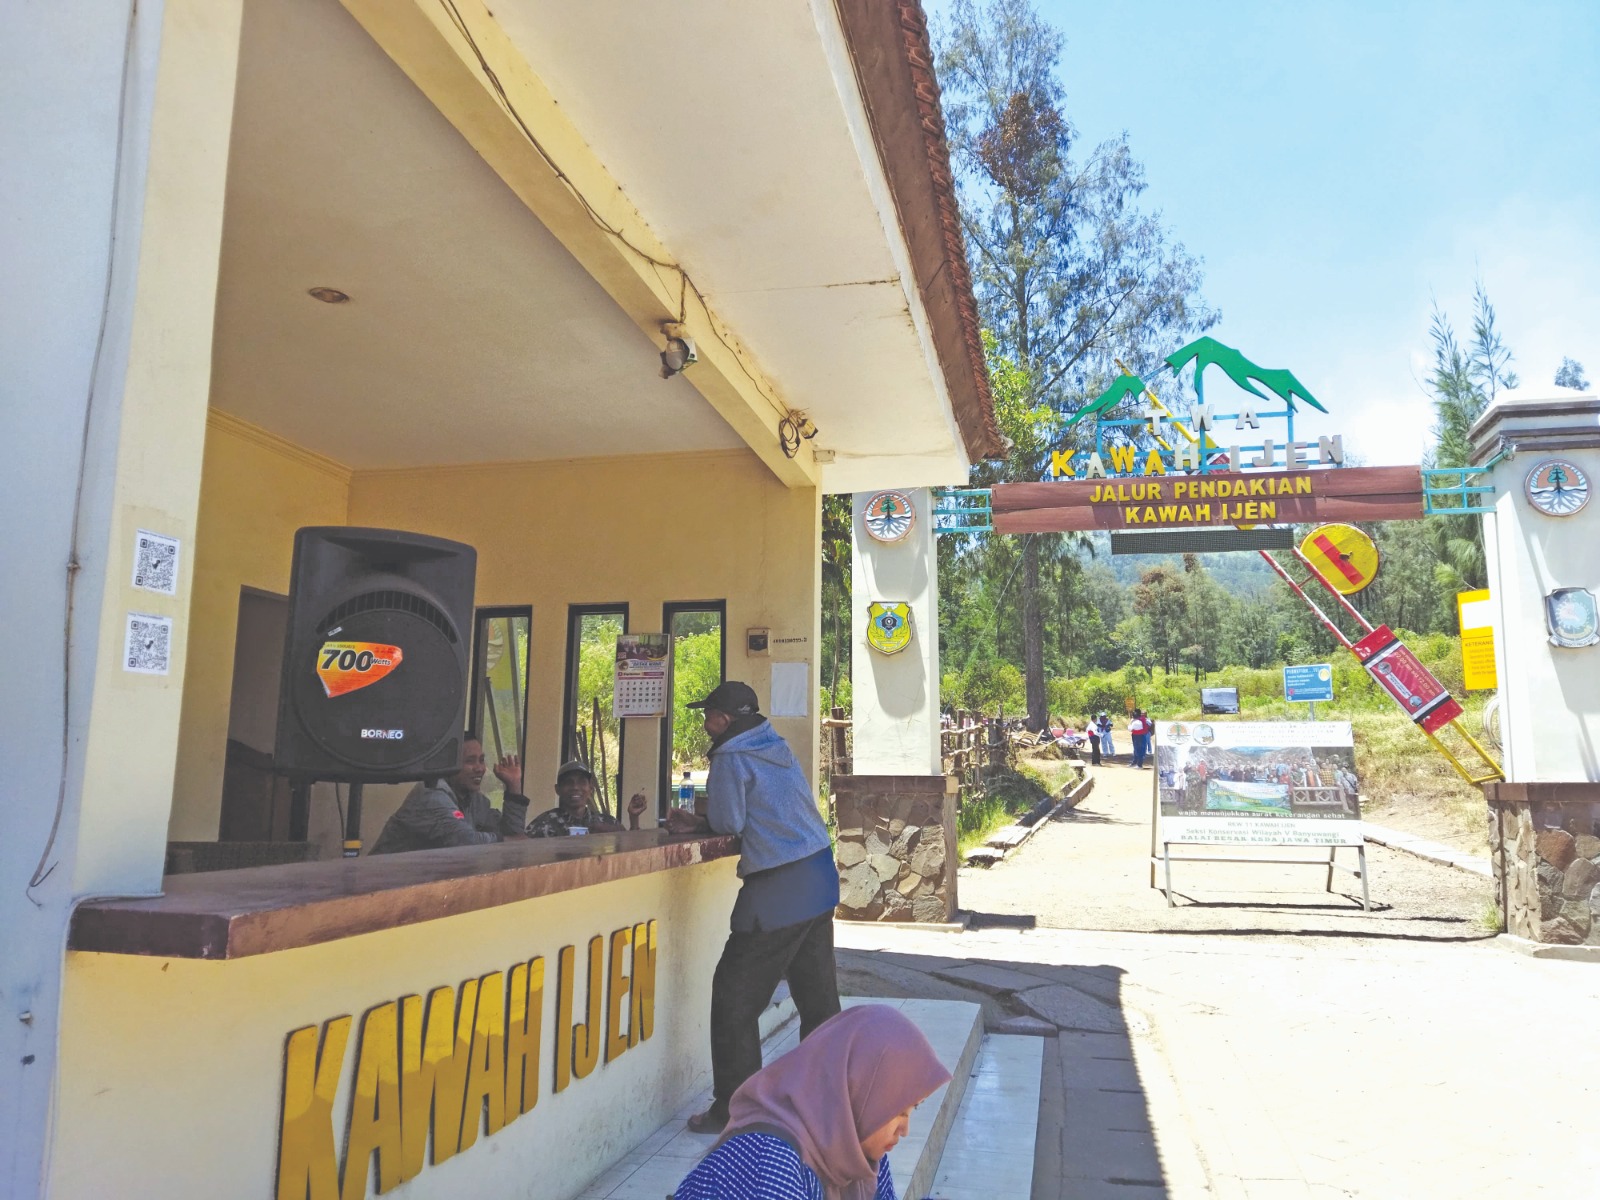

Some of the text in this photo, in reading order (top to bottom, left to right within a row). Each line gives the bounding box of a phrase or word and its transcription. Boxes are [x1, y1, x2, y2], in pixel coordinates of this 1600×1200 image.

[1051, 434, 1343, 479] KAWAH IJEN
[1089, 476, 1312, 503] JALUR PENDAKIAN
[1125, 501, 1277, 524] KAWAH IJEN
[321, 649, 375, 673] 700
[371, 657, 391, 666] Watts
[361, 728, 404, 740] BORNEO
[1178, 810, 1198, 818] wajib
[1252, 829, 1282, 838] Wilayah
[1292, 830, 1339, 839] Banyuwangi
[274, 918, 658, 1200] KAWAH IJEN
